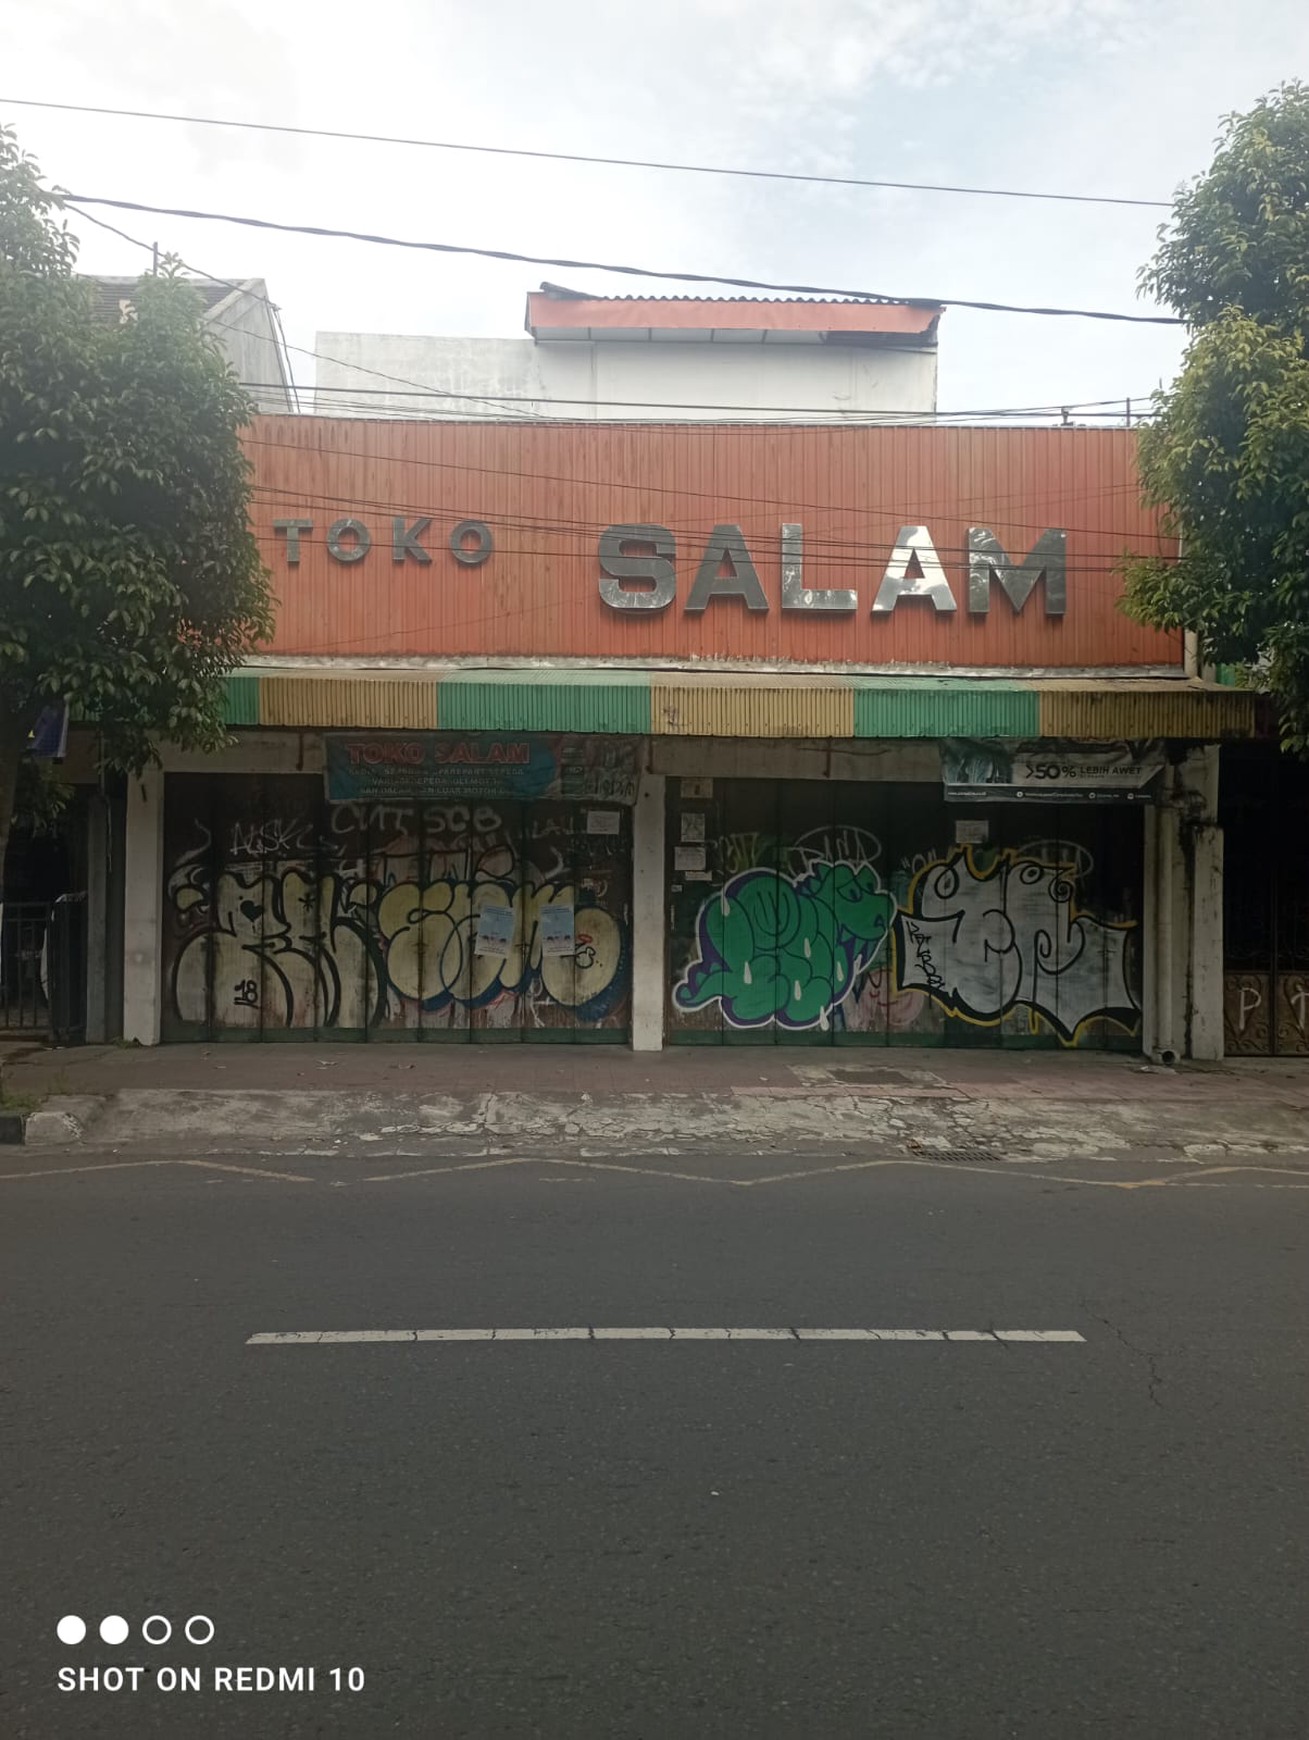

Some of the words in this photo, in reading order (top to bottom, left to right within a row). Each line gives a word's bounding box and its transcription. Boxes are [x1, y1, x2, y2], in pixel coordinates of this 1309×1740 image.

[273, 515, 493, 564] TOKO
[598, 523, 1067, 616] SALAM
[347, 742, 425, 765] TOKO
[434, 742, 530, 764] SALAM
[1112, 766, 1142, 775] AWET
[234, 979, 259, 1008] 18
